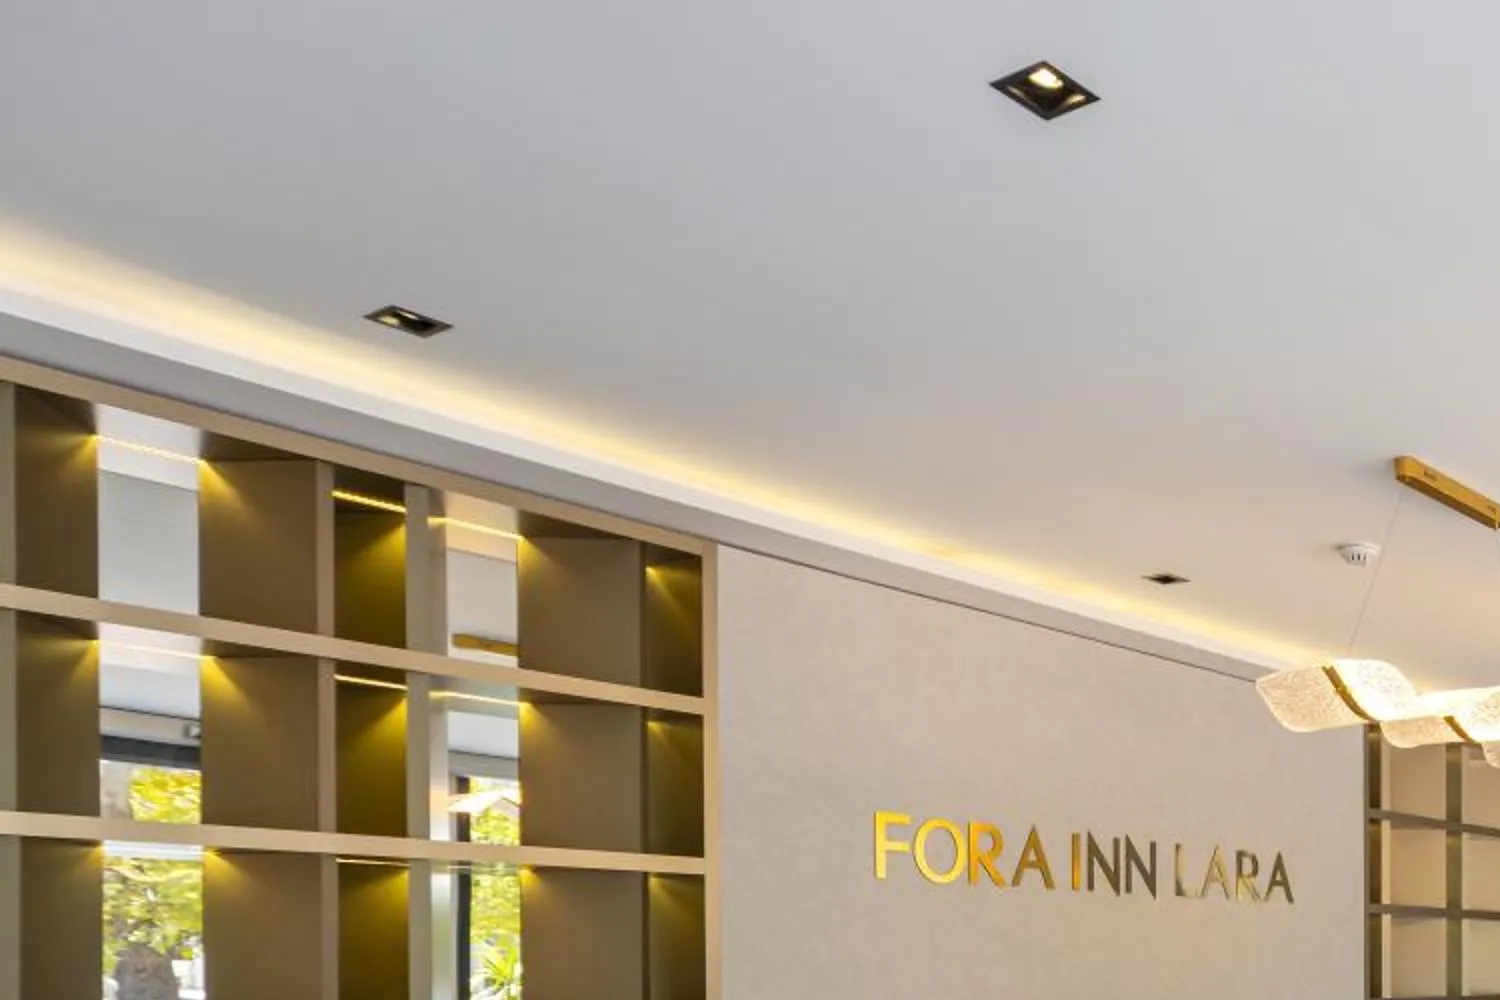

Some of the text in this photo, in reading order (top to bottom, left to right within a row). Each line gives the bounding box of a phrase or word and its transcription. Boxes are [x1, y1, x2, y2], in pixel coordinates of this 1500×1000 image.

[873, 810, 1295, 904] FORA INN LARA
